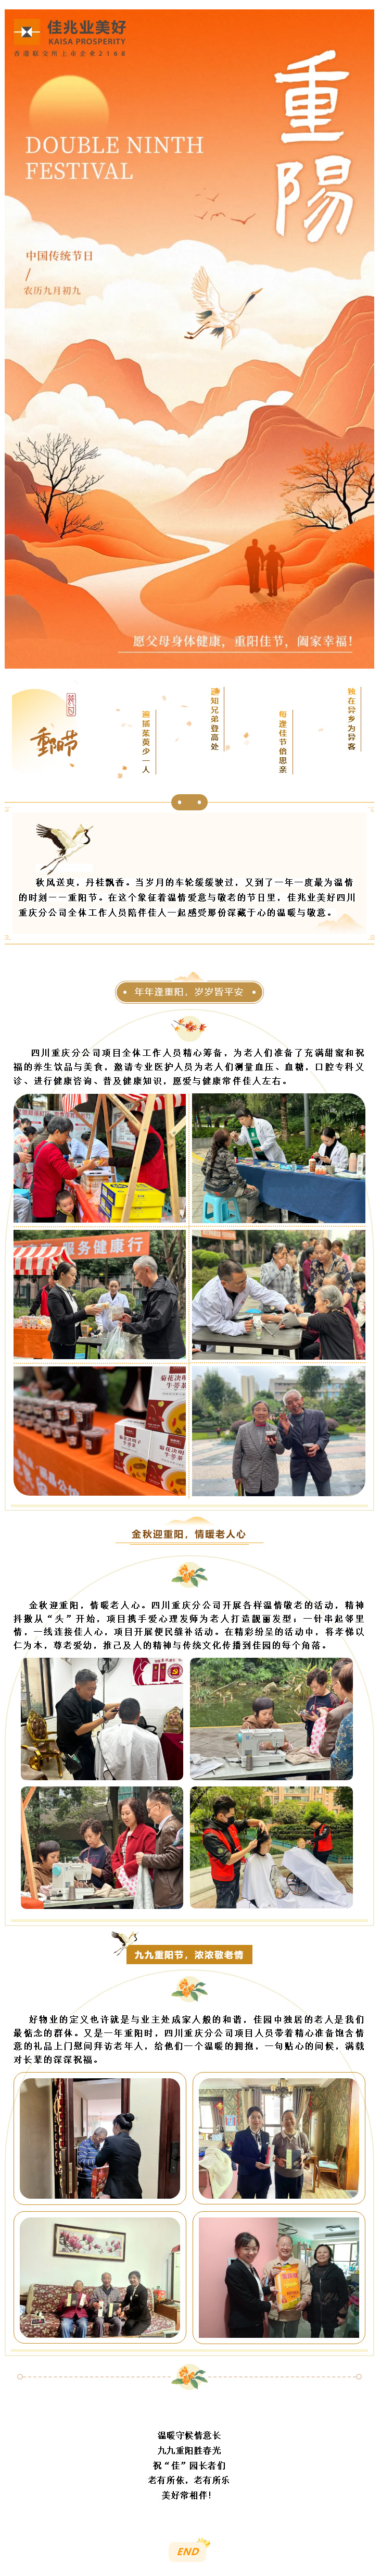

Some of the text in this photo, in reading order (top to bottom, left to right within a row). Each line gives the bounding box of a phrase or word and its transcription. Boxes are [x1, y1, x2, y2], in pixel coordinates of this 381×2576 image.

[47, 19, 126, 35] 佳兆业美好
[26, 137, 204, 154] DOUBLE NINTH
[26, 162, 133, 180] FESTIVAL
[26, 250, 93, 262] 中国传统节日
[24, 286, 81, 295] 农历九月初九
[211, 687, 219, 750] 遥知兄弟登高处
[348, 687, 356, 750] 独在异乡为异客
[142, 710, 150, 773] 遍插茱萸少一人
[279, 710, 287, 773] 每逢佳节倍思亲
[35, 878, 353, 887] 秋风送爽，丹桂飘香。当岁月的车轮缓缓驶过，又到了一年一度最为温情
[19, 908, 332, 917] 重庆分公司全体工作人员陪伴佳人一起感受那份深藏于心的温暖与敬意。
[134, 987, 244, 997] 年年逢重阳，岁岁皆平安
[31, 1049, 364, 1057] 四川重庆分公司项目全体工作人员精心筹备，为老人们准备了充满甜蜜和祝
[14, 1063, 364, 1071] 福的养生饮品与美食，邀请专业医护人员为老人们测量血压、血糖，口腔专科义
[14, 1077, 288, 1086] 诊、进行健康咨询、普及健康知识，愿爱与健康常伴佳人左右。
[131, 1529, 246, 1539] 金秋迎重阳，情暖老人心
[29, 1601, 364, 1610] 金秋迎重阳，情暖老人心。四川重庆分公司开展各样温情敬老的活动，精神
[14, 1628, 364, 1636] 情，一线连接佳人心，项目开展便民缝补活动。在精彩纷呈的活动中，将孝悌以
[14, 1641, 327, 1650] 仁为本，尊老爱幼，推己及人的精神与传统文化传播到佳园的每个角落。
[134, 1950, 244, 1960] 九九重阳节，浓浓敬老情
[29, 2015, 364, 2024] 好物业的定义也许就是与业主处成家人般的和谐，佳园中独居的老人是我们
[14, 2029, 364, 2038] 最惦念的群体。又是一年重阳时，四川重庆分公司项目人员带着精心准备饱含情
[14, 2042, 364, 2051] 意的礼品上门慰问拜访老年人，给他们一个温暖的拥抱，一句贴心的问候，满载
[14, 2055, 98, 2064] 对长辈的深深祝福。
[157, 2431, 221, 2440] 温暖守候情意长
[157, 2446, 221, 2455] 九九重阳胜春光
[148, 2476, 230, 2485] 老有所依，老有所乐
[161, 2491, 211, 2500] 美好常相伴！
[177, 2547, 200, 2556] END
